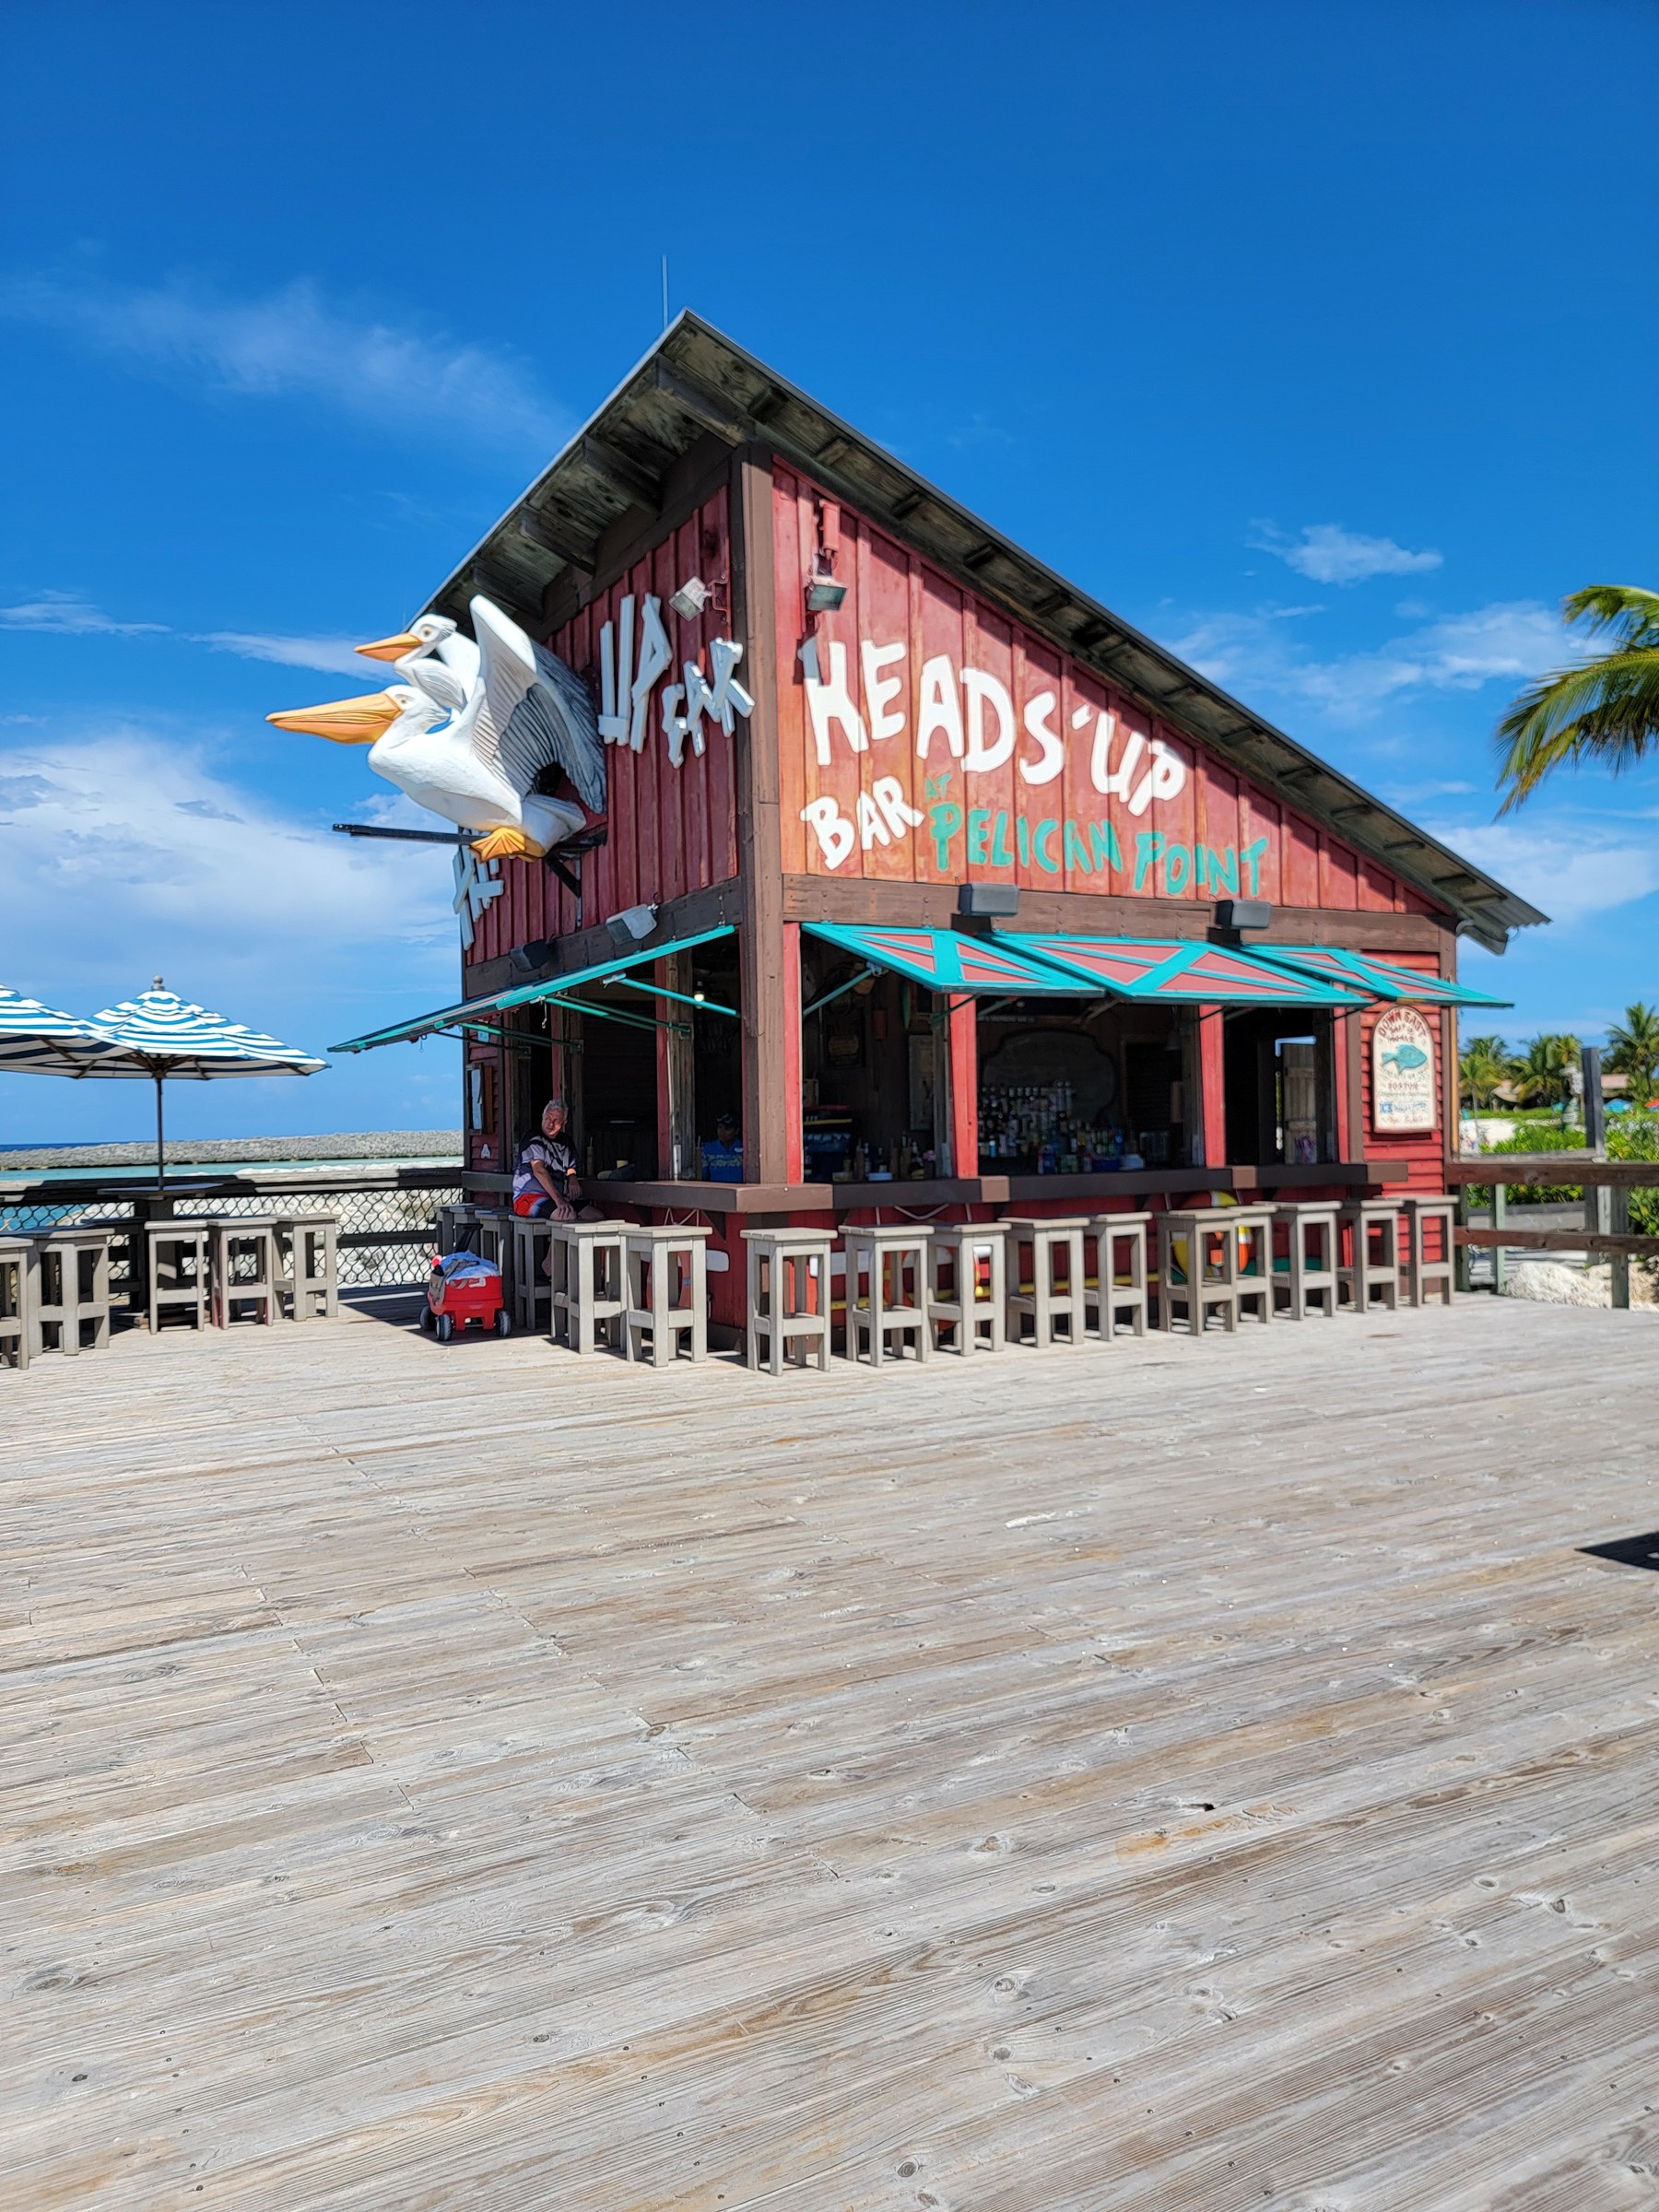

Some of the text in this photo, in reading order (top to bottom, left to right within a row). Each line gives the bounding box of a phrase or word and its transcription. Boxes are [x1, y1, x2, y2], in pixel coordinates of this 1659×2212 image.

[800, 775, 924, 870] BAR
[925, 773, 952, 801] AT
[929, 803, 1267, 897] PELICAN POINT
